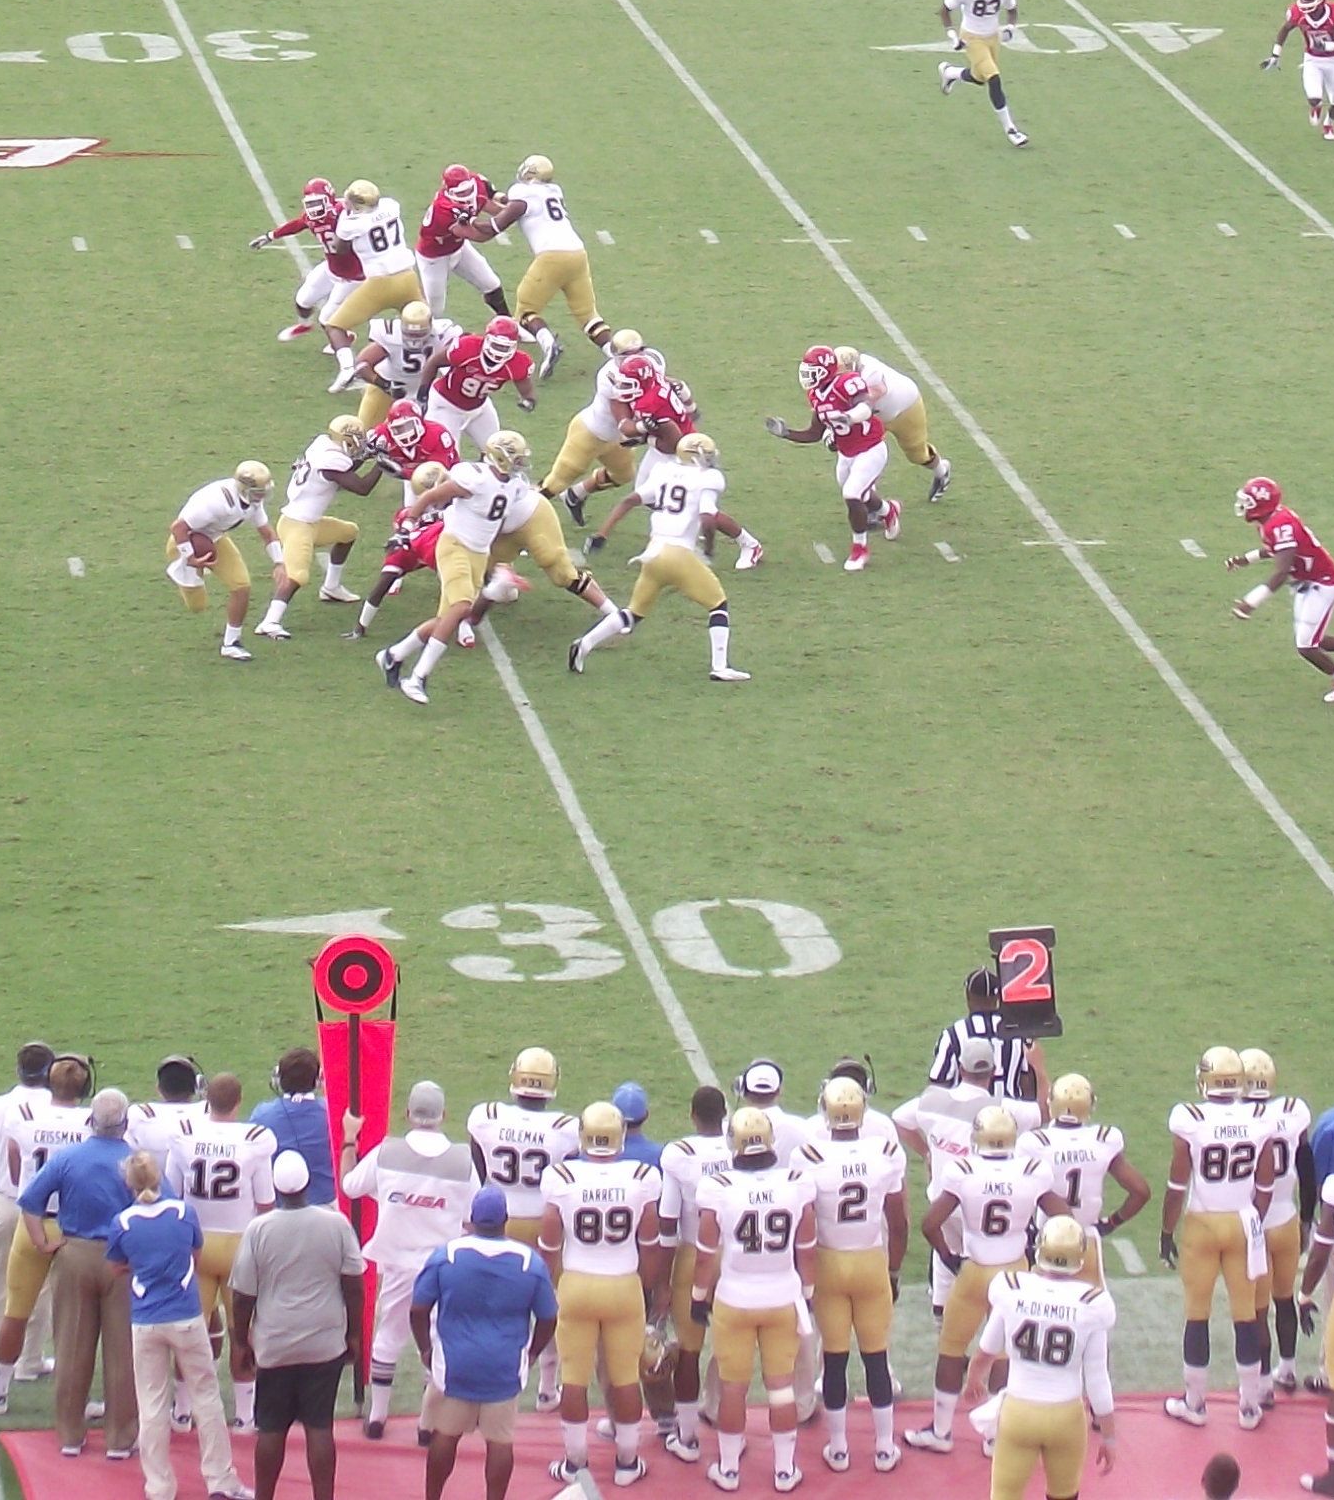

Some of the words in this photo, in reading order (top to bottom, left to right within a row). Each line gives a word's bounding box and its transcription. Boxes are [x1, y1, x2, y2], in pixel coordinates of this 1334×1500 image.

[972, 0, 1001, 17] 83
[66, 30, 318, 62] 30
[369, 219, 400, 252] 87
[486, 494, 508, 521] 8
[653, 484, 688, 514] 19
[440, 899, 843, 981] 30
[999, 937, 1052, 1003] 2
[33, 1129, 82, 1145] CRISSMAN
[499, 1127, 546, 1145] COLEMAN
[490, 1146, 551, 1188] 33
[841, 1162, 868, 1178] BARR
[1053, 1150, 1097, 1165] CARROLL
[1200, 1140, 1257, 1184] 82
[189, 1158, 242, 1201] 12
[581, 1187, 627, 1204] BARRETT
[981, 1181, 1014, 1196] JAMES
[1065, 1168, 1083, 1208] 1
[837, 1181, 868, 1223] 2
[981, 1200, 1011, 1236] 6
[572, 1206, 634, 1245] 89
[734, 1209, 793, 1253] 49
[1015, 1299, 1078, 1322] McDERMOTT
[1010, 1318, 1076, 1366] 48
